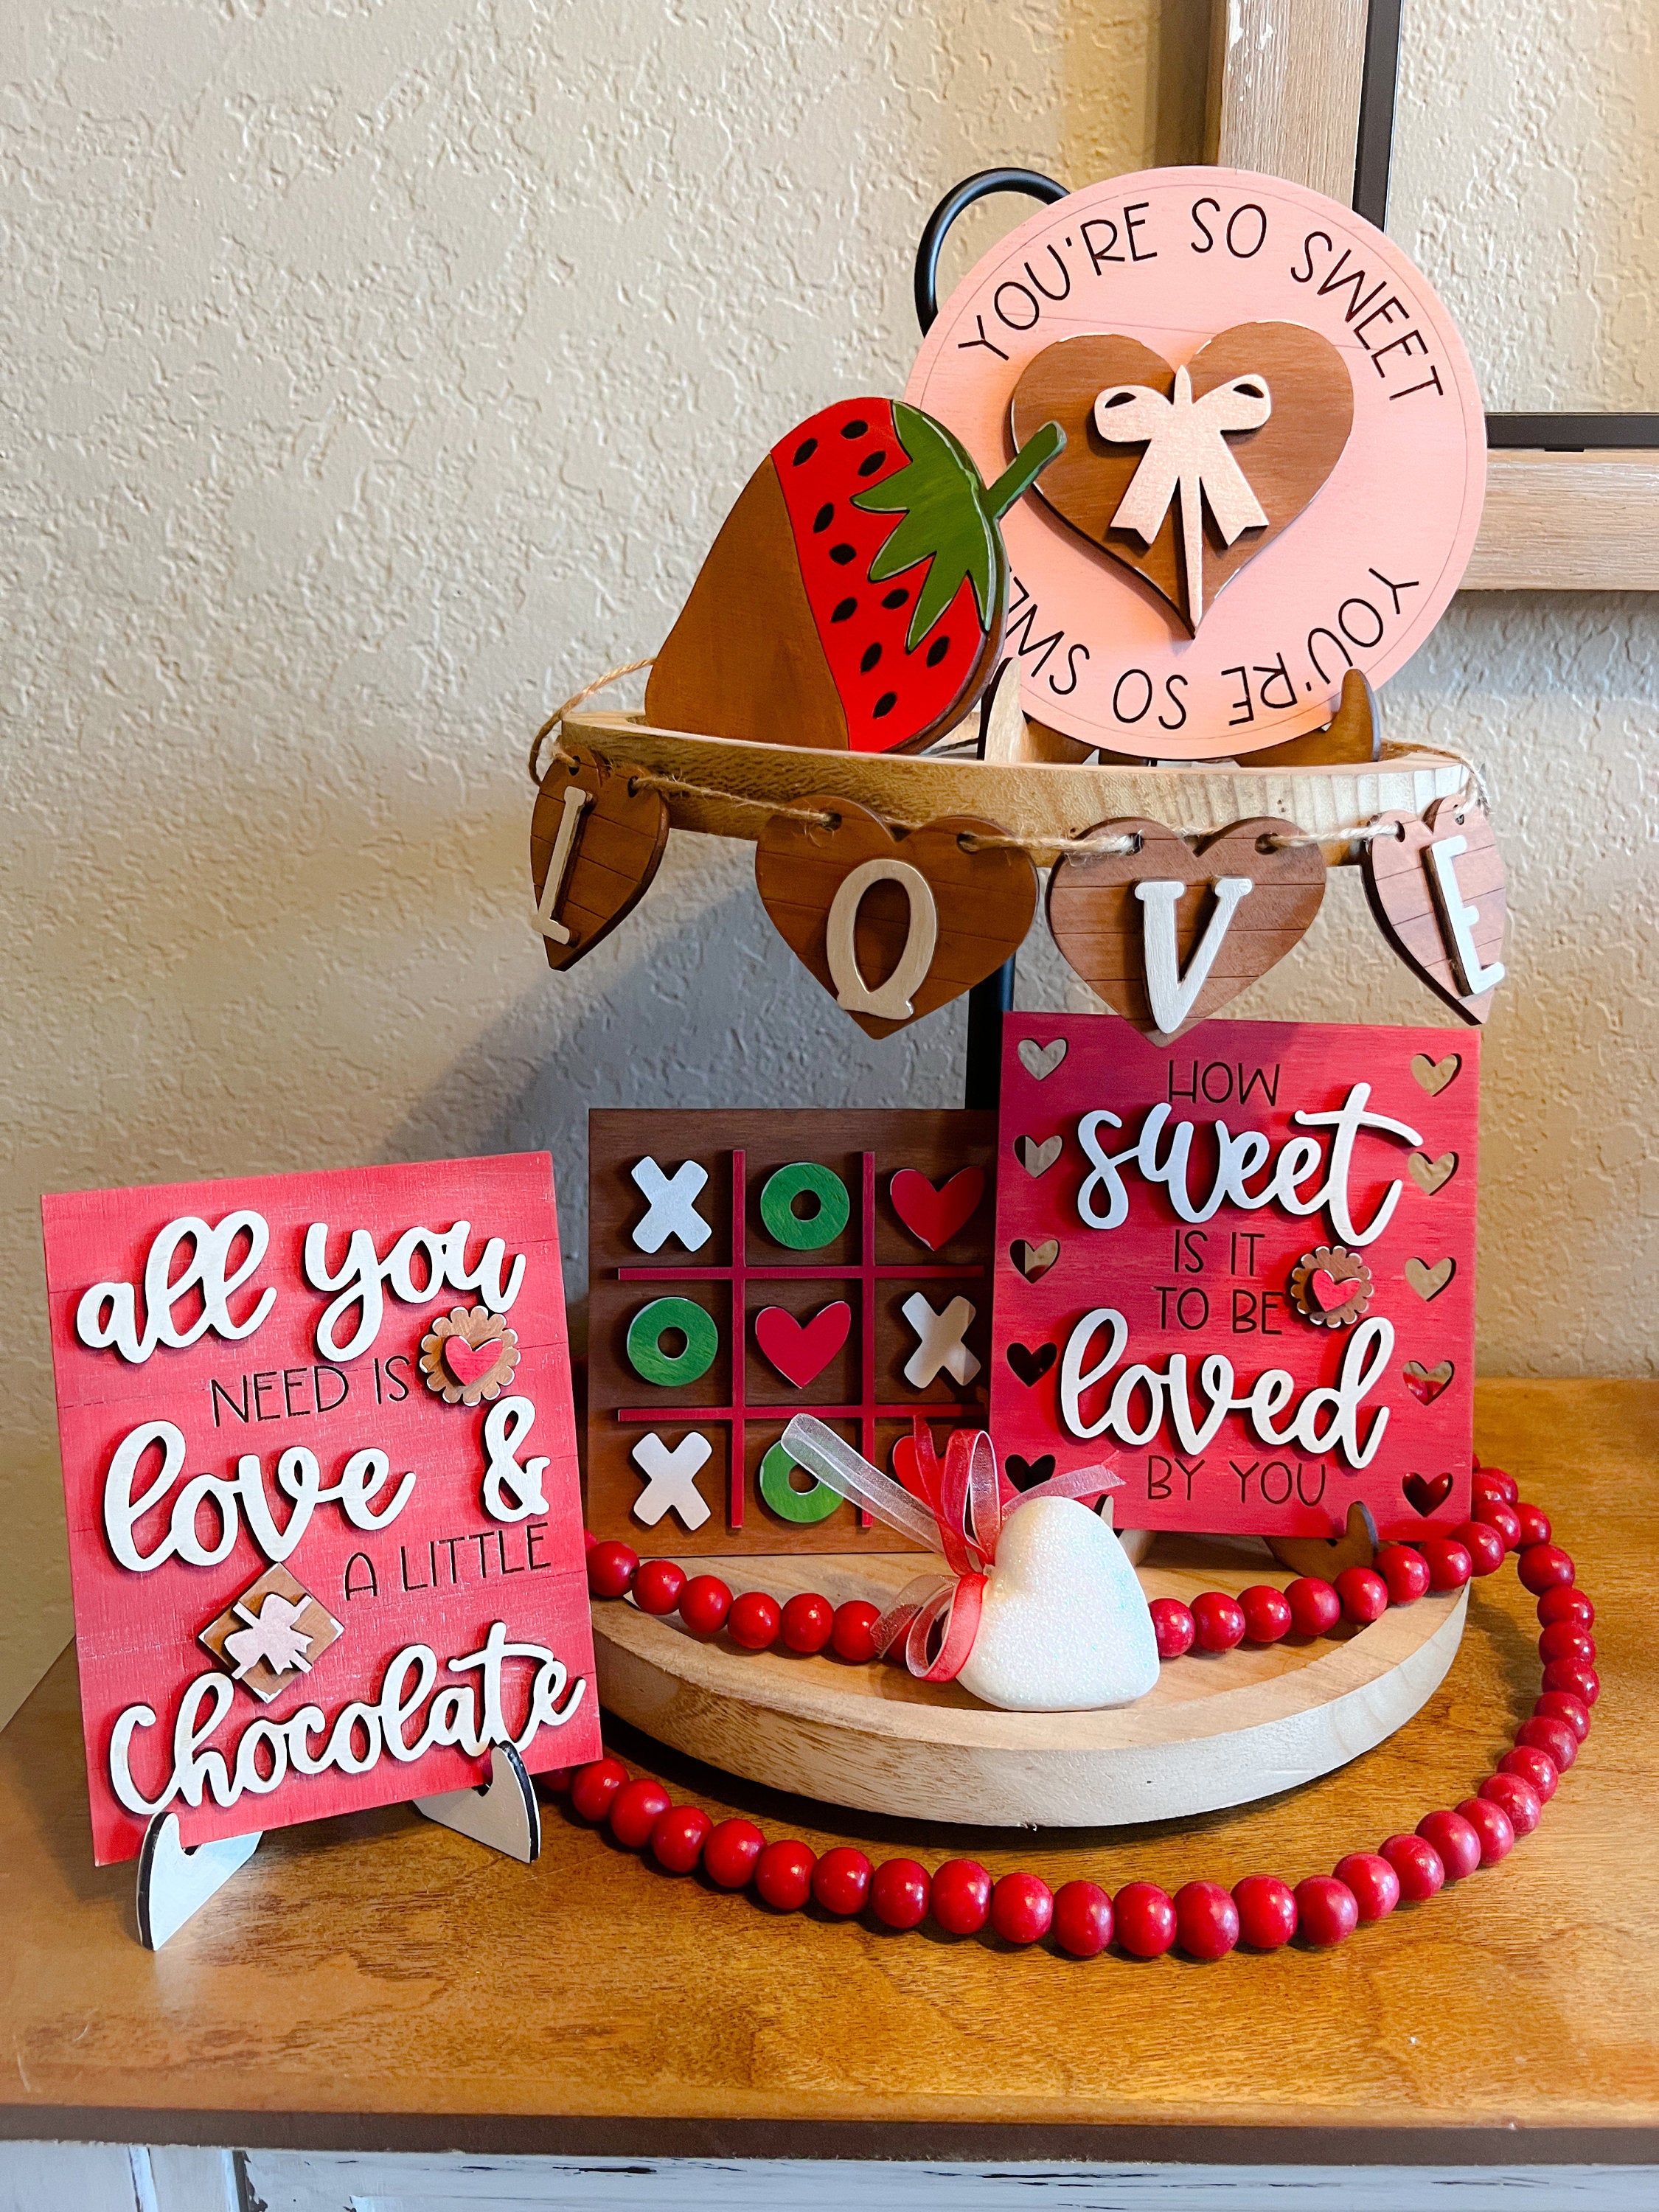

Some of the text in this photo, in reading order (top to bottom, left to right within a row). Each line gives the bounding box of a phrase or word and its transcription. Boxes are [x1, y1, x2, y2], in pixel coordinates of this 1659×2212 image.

[958, 197, 1444, 401] YOU'RE SO SWEET
[1006, 566, 1420, 730] YOU'RE SO SW
[1168, 1060, 1281, 1107] HOW
[1077, 1082, 1425, 1246] sweet
[76, 1209, 527, 1365] all you
[1152, 1285, 1283, 1335] TO BE
[1174, 1229, 1267, 1276] IS IT
[210, 1354, 411, 1427] NEED IS
[1060, 1307, 1395, 1470] loved
[103, 1394, 552, 1574] love &
[1147, 1455, 1326, 1508] BY YOU
[345, 1521, 552, 1601] A LITTLE
